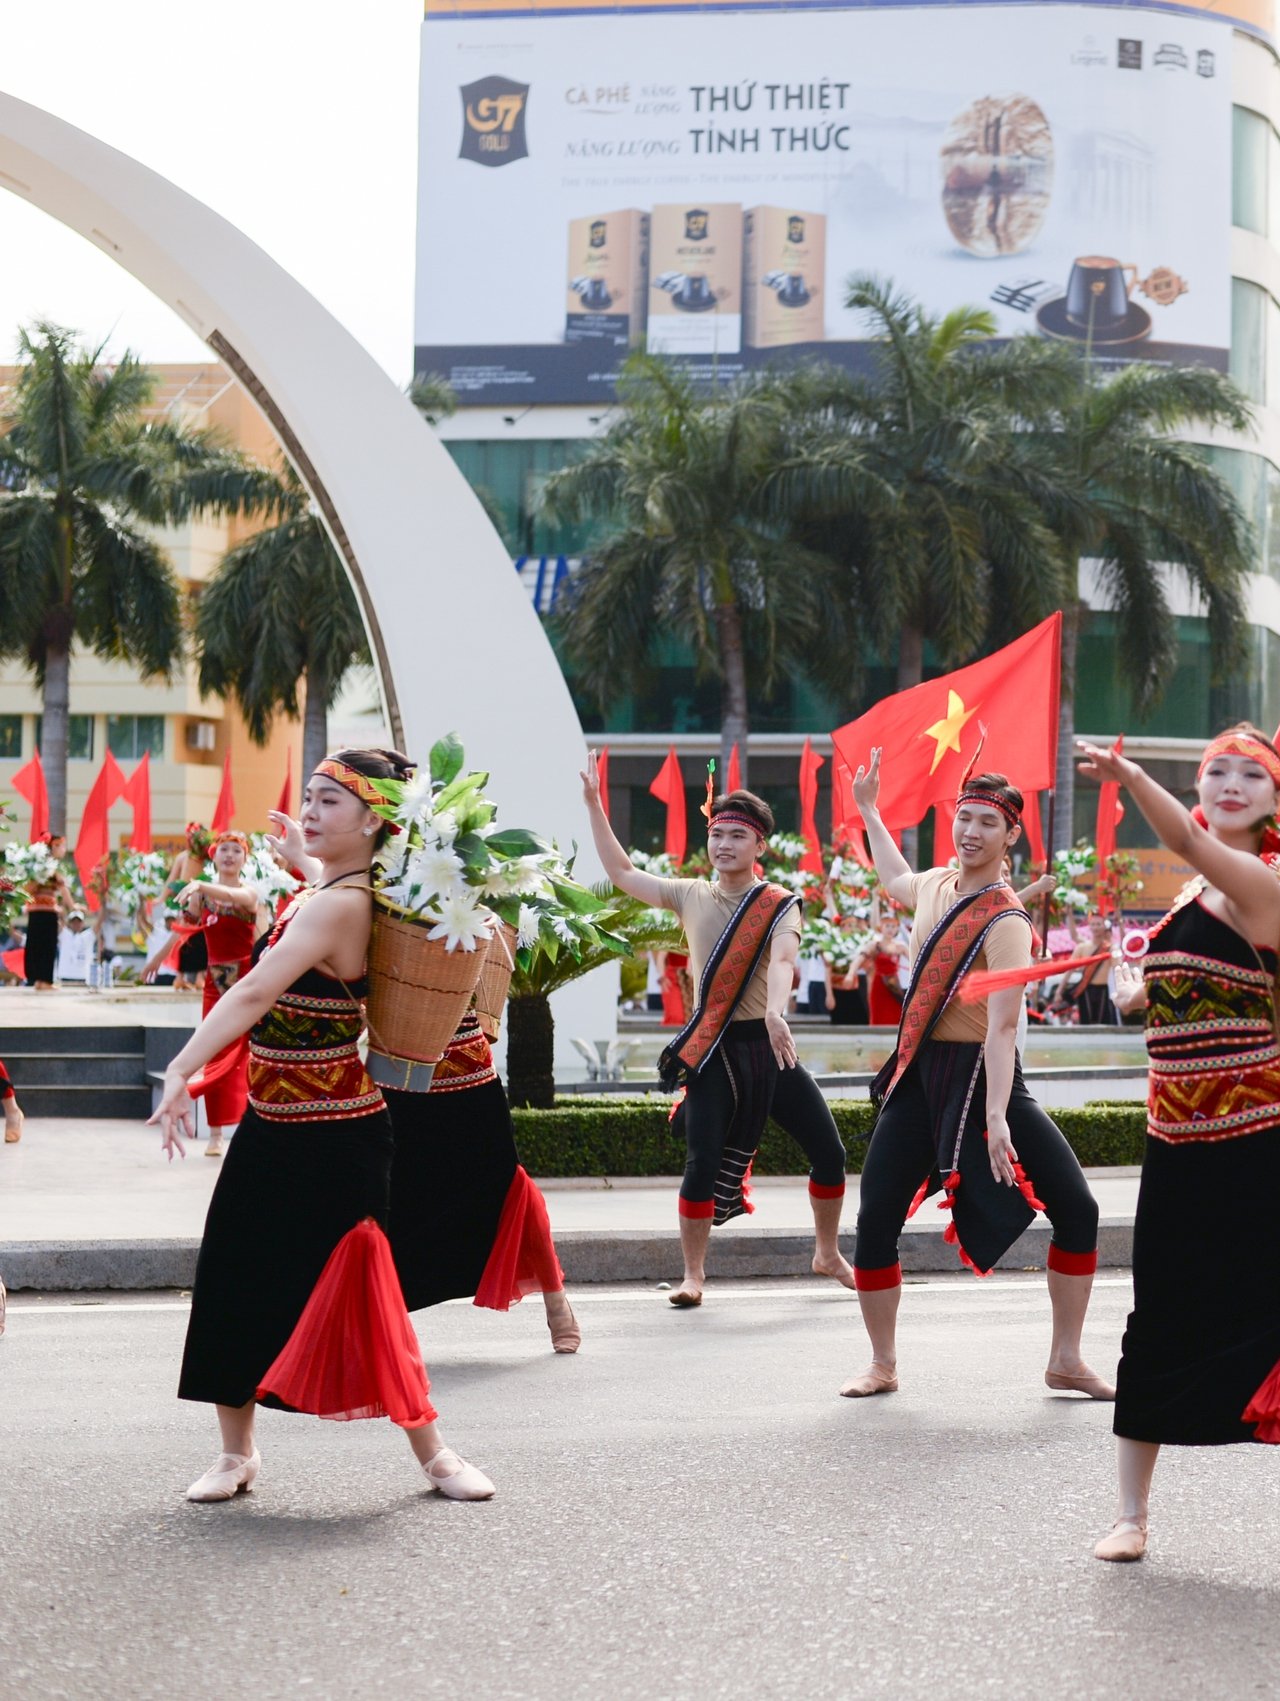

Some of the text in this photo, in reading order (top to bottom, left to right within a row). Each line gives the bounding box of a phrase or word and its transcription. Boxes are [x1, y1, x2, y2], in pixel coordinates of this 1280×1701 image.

[565, 81, 631, 105] CÀ PHÊ
[690, 76, 851, 116] THỨ THIỆT
[564, 119, 851, 160] NĂNG LƯỢNG TỈNH THỨC
